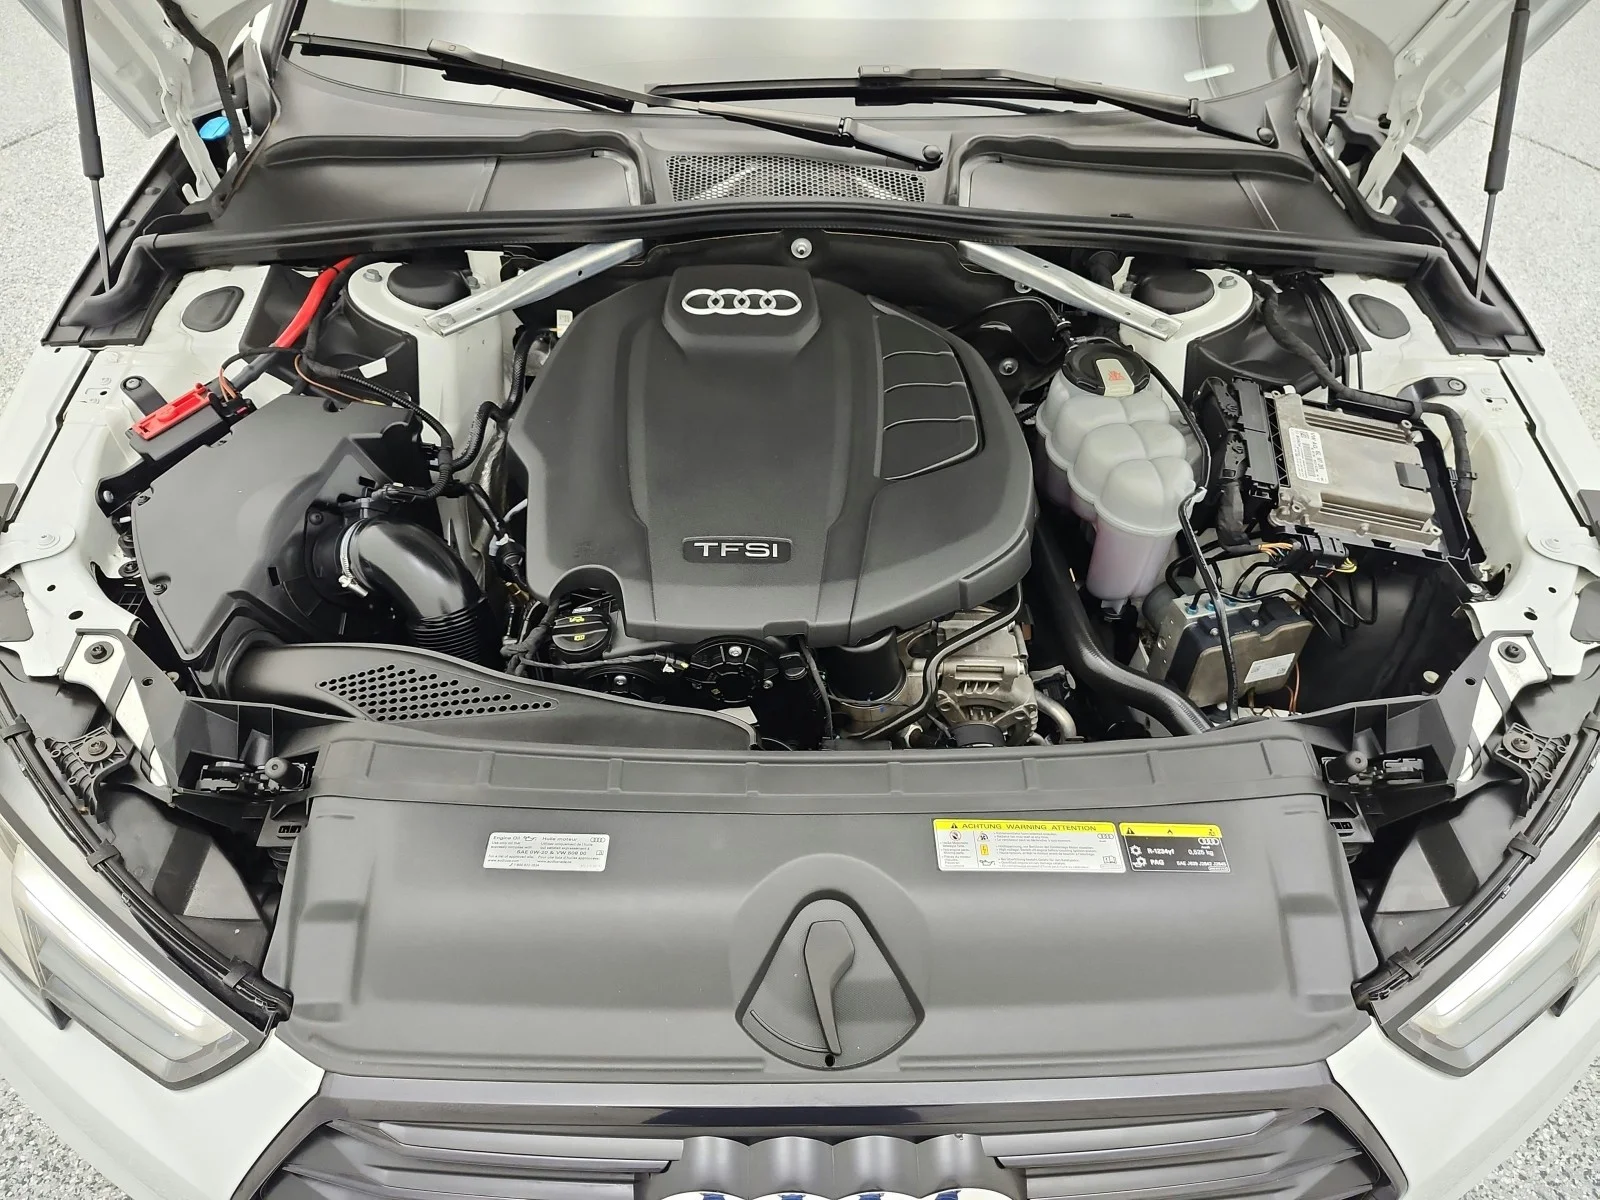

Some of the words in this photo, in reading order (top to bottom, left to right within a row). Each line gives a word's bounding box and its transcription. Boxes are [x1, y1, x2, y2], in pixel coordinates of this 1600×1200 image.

[693, 542, 778, 558] TFSI
[1005, 823, 1047, 831] WARNING
[1146, 847, 1175, 856] R-1234yf
[1205, 849, 1214, 857] kg
[1149, 858, 1165, 866] PAG
